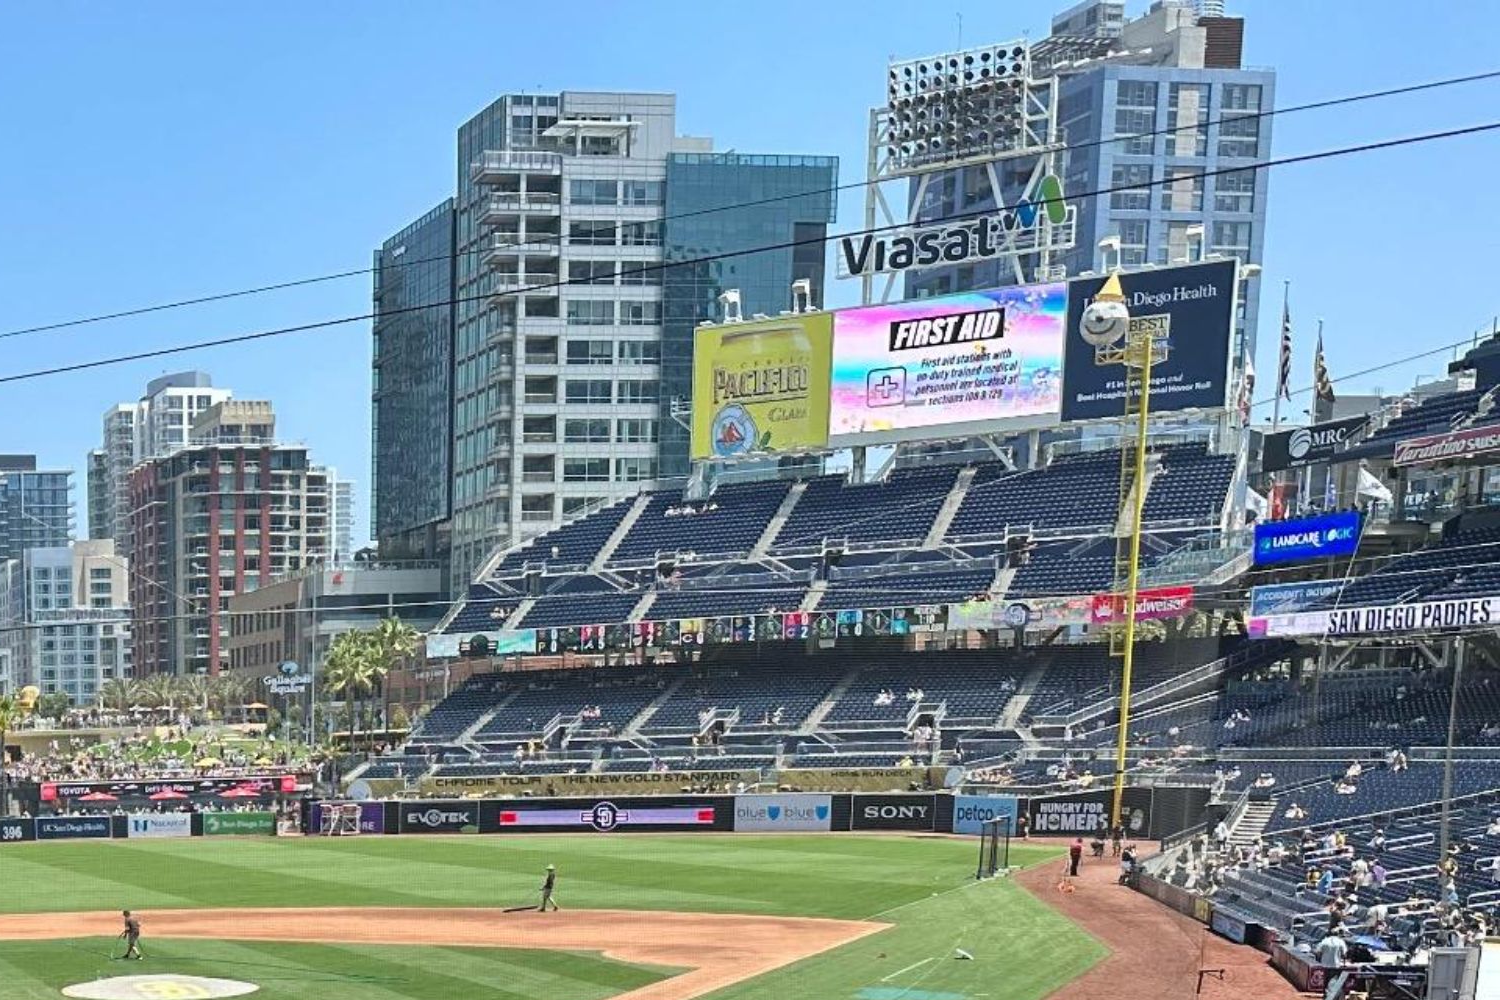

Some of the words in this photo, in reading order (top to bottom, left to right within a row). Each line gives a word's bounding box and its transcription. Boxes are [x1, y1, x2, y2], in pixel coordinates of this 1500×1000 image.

[842, 217, 996, 275] Viasat
[1133, 291, 1171, 307] Diego
[1173, 284, 1217, 301] Health
[893, 316, 960, 350] FIRST
[957, 311, 1001, 341] AID
[1129, 317, 1167, 332] BEST
[921, 357, 941, 368] First
[942, 354, 955, 367] aid
[955, 352, 991, 366] stations
[992, 348, 1012, 361] with
[916, 368, 950, 382] on-duty
[951, 365, 983, 378] trained
[983, 361, 1018, 376] medical
[713, 364, 809, 405] PACIFICO
[915, 381, 957, 396] personnel
[959, 379, 974, 391] are
[974, 375, 1008, 390] located
[1009, 375, 1018, 386] at
[928, 393, 964, 406] sections
[1312, 427, 1346, 446] MRC
[1396, 437, 1467, 463] Tarantino
[1273, 531, 1322, 548] LANDCARE
[1328, 609, 1363, 634] SAN
[1365, 605, 1415, 631] DIEGO
[1420, 599, 1491, 628] PADRES
[436, 777, 495, 787] CHROME
[502, 776, 542, 786] TOUR
[561, 776, 589, 785] THE
[590, 774, 622, 784] NEW
[623, 773, 662, 784] GOLD
[664, 772, 741, 783] STANDARD
[59, 787, 91, 795] TOYOTA
[737, 806, 766, 820] blue
[784, 806, 815, 820] blue
[864, 805, 928, 819] SONY
[957, 804, 993, 822] petco
[1040, 803, 1082, 814] HUNGRY
[1084, 801, 1104, 813] FOR
[407, 809, 469, 827] EVOTEK
[1035, 813, 1109, 831] HOMERS
[2, 826, 22, 840] 396
